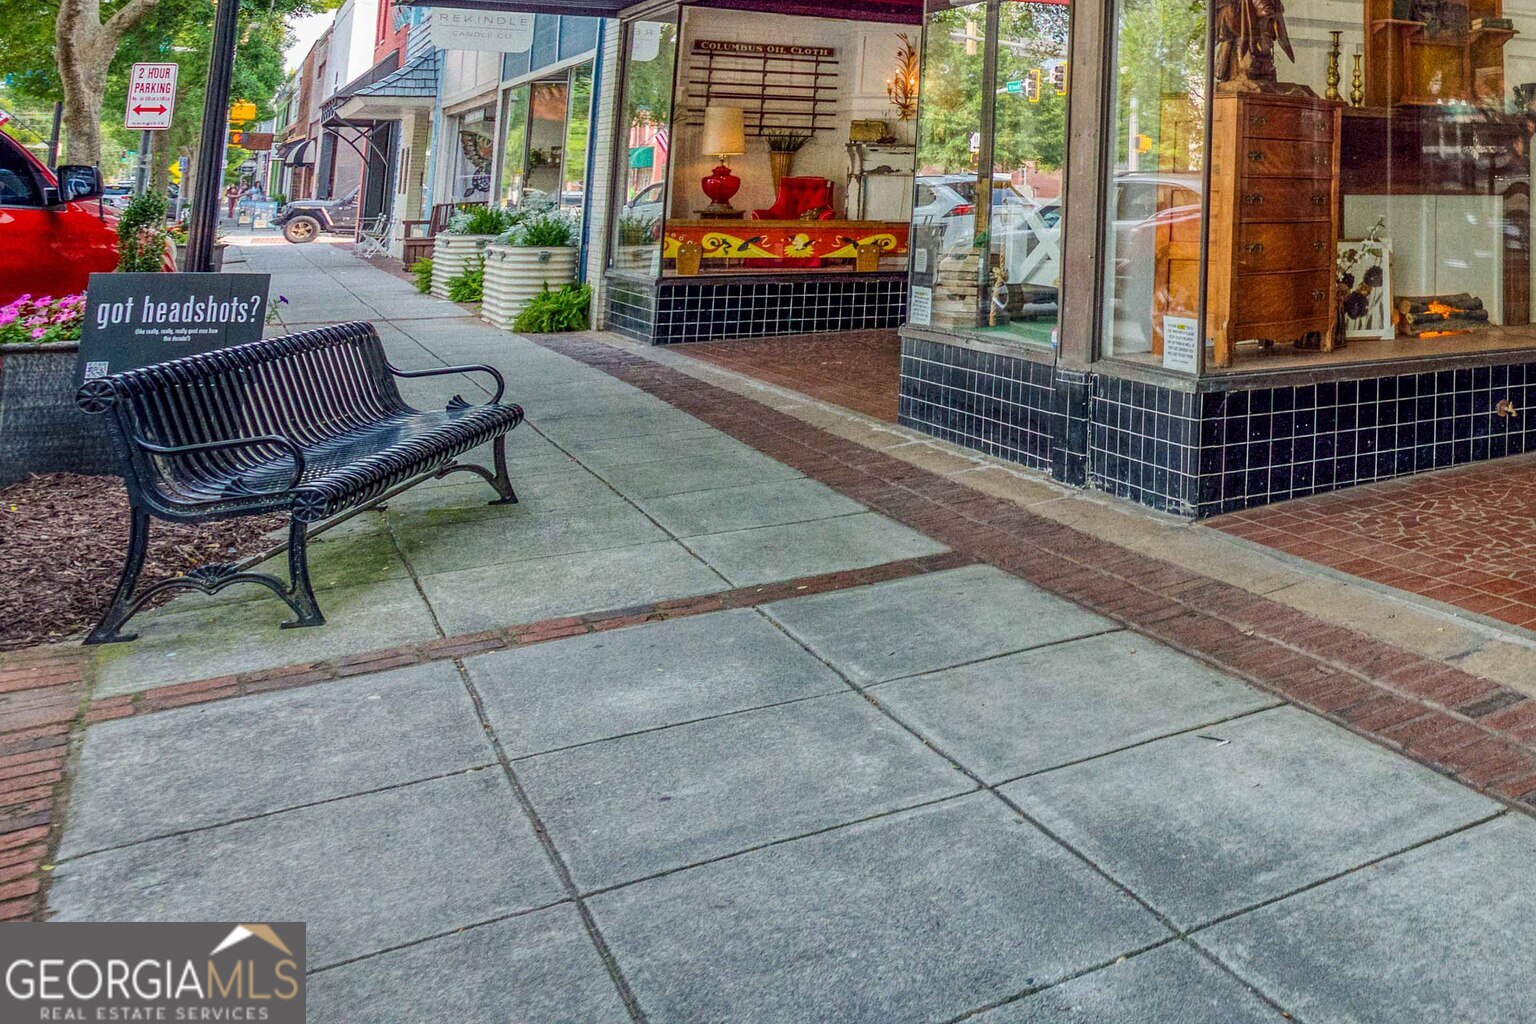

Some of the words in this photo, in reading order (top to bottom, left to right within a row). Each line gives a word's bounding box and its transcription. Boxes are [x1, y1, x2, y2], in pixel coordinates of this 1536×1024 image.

[440, 13, 529, 26] REKINDLE
[452, 30, 493, 39] CANDLE
[701, 41, 763, 52] COLUMBUS
[767, 46, 787, 54] OIL
[791, 47, 828, 56] CLOTH
[139, 67, 145, 79] 2
[148, 67, 171, 79] HOUR
[135, 83, 171, 94] PARKING
[97, 297, 134, 329] got
[142, 295, 261, 323] headshots?
